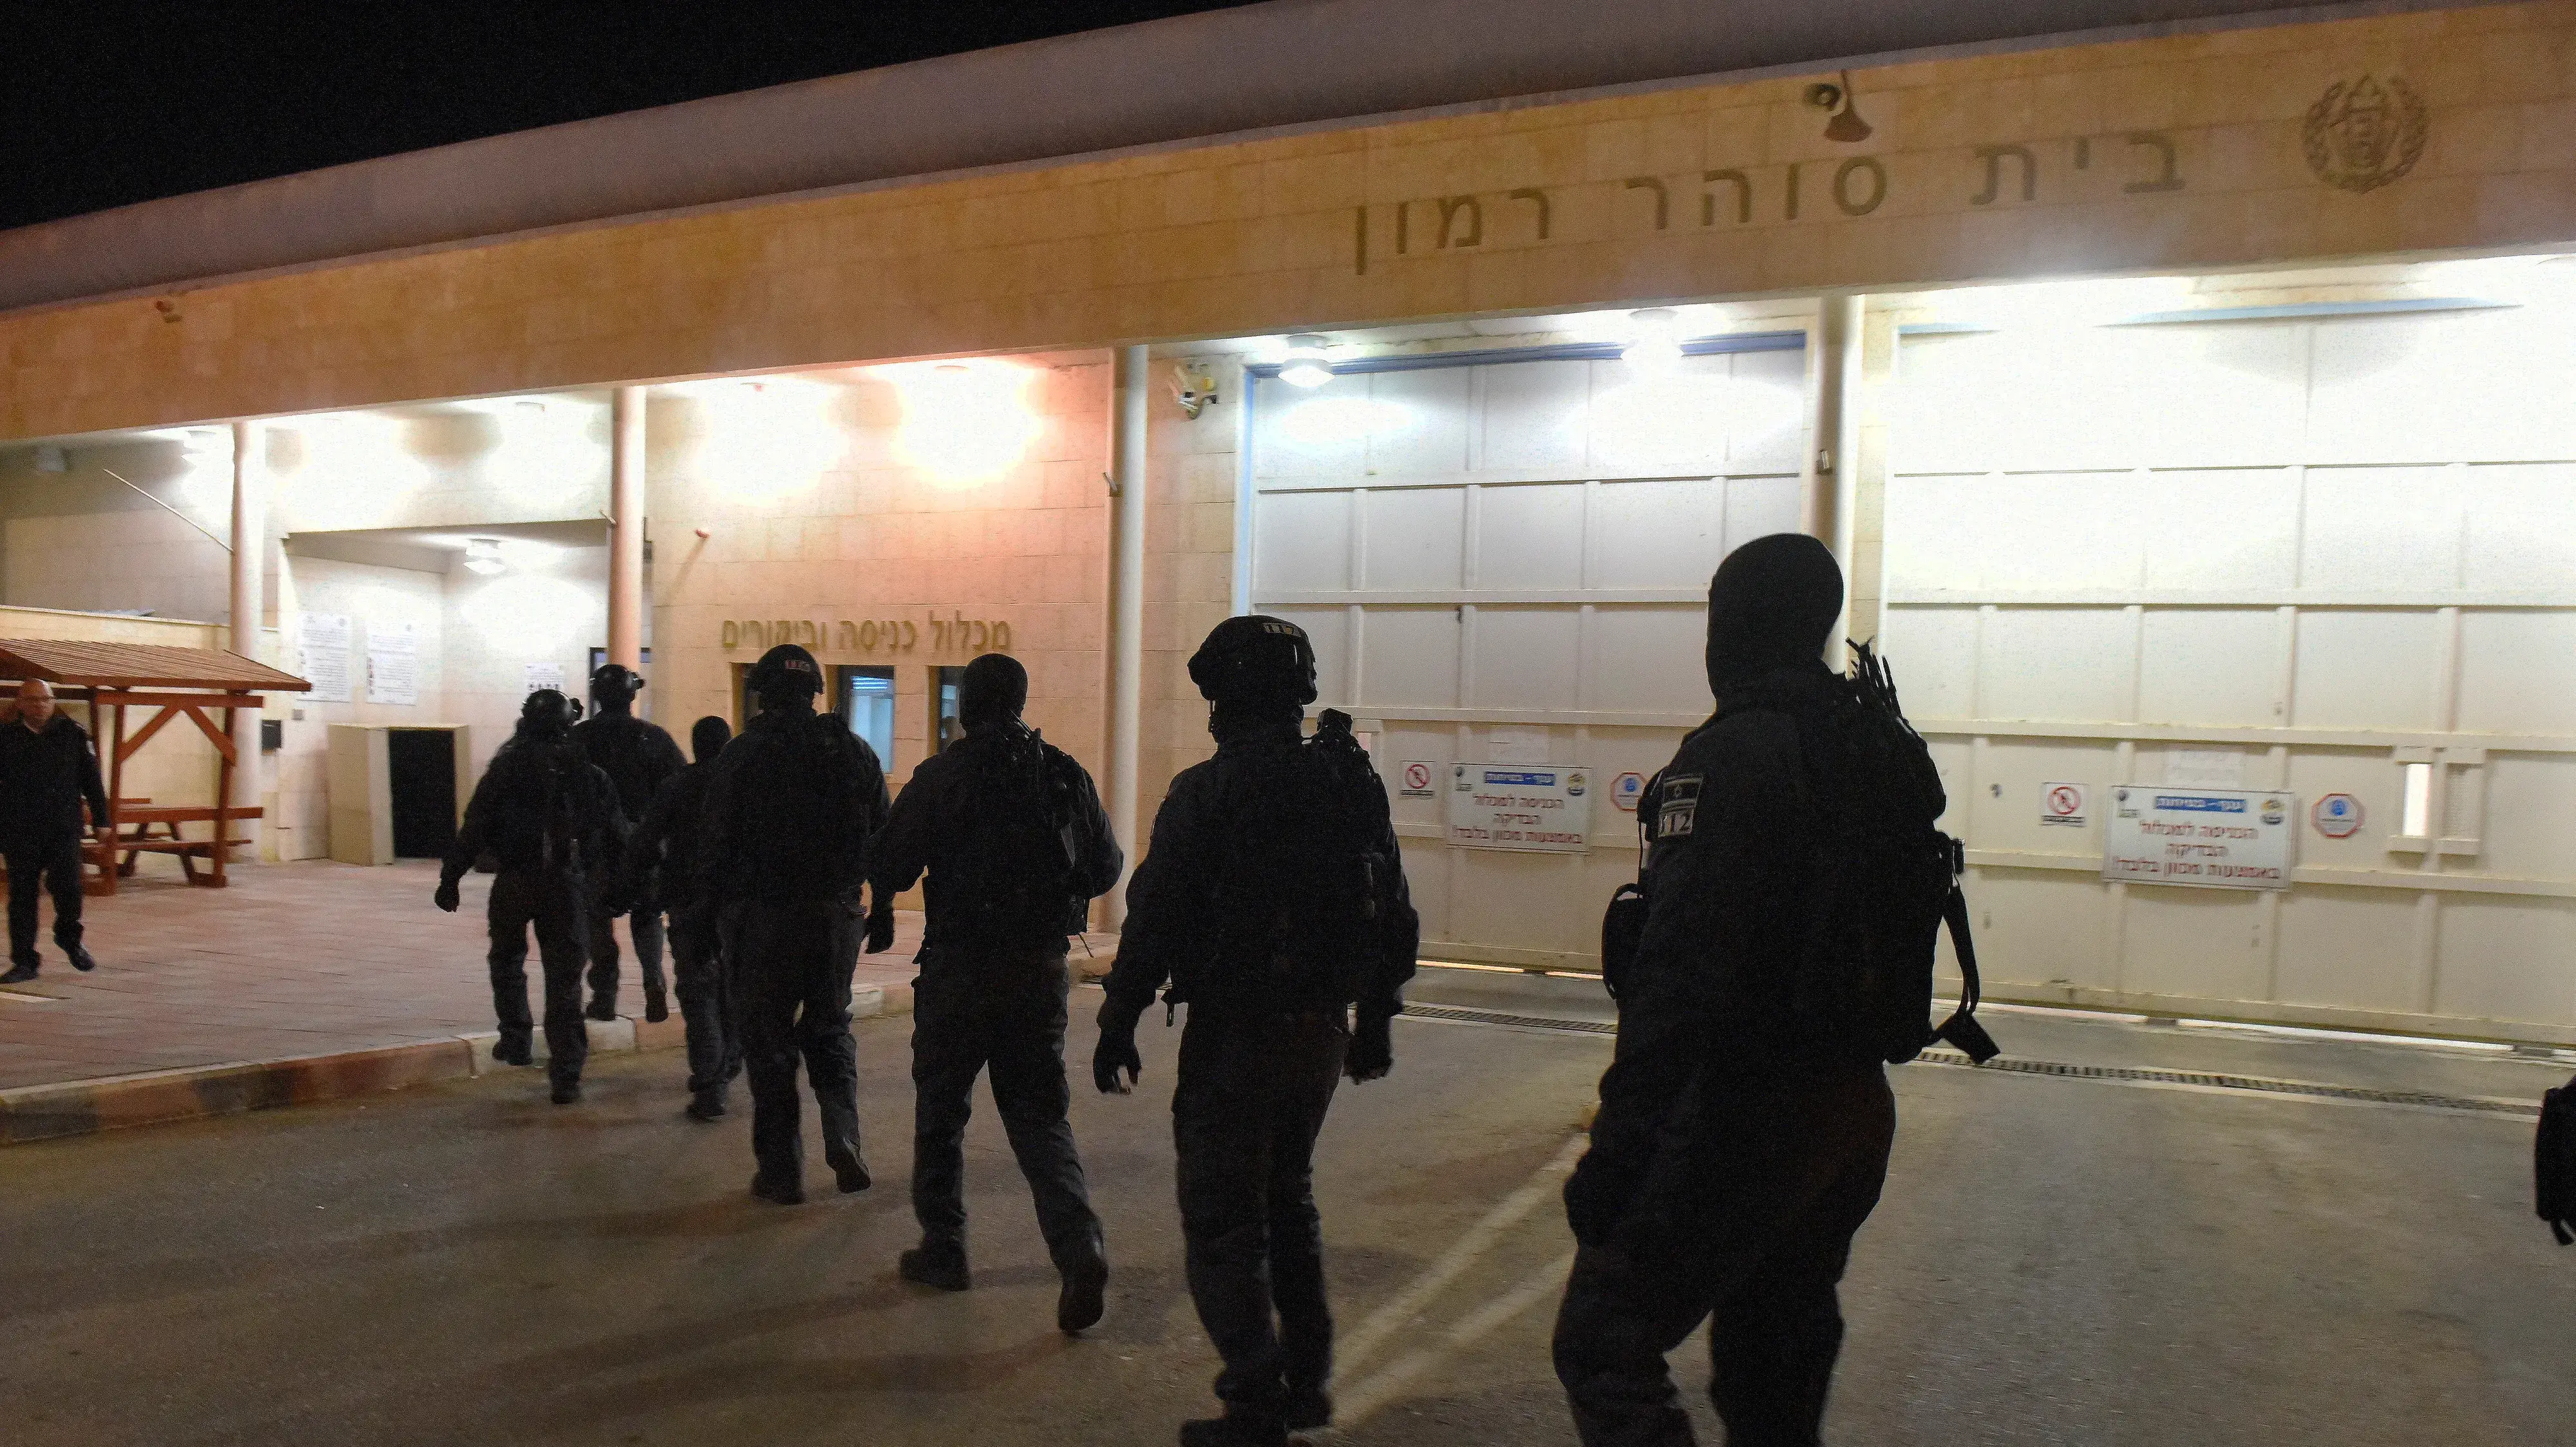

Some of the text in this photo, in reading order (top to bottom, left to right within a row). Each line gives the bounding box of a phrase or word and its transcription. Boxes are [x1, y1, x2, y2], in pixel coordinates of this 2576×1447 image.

[1356, 129, 2186, 276] בית סוהר רמון
[721, 610, 1012, 650] מכלול כניסה וביקורים
